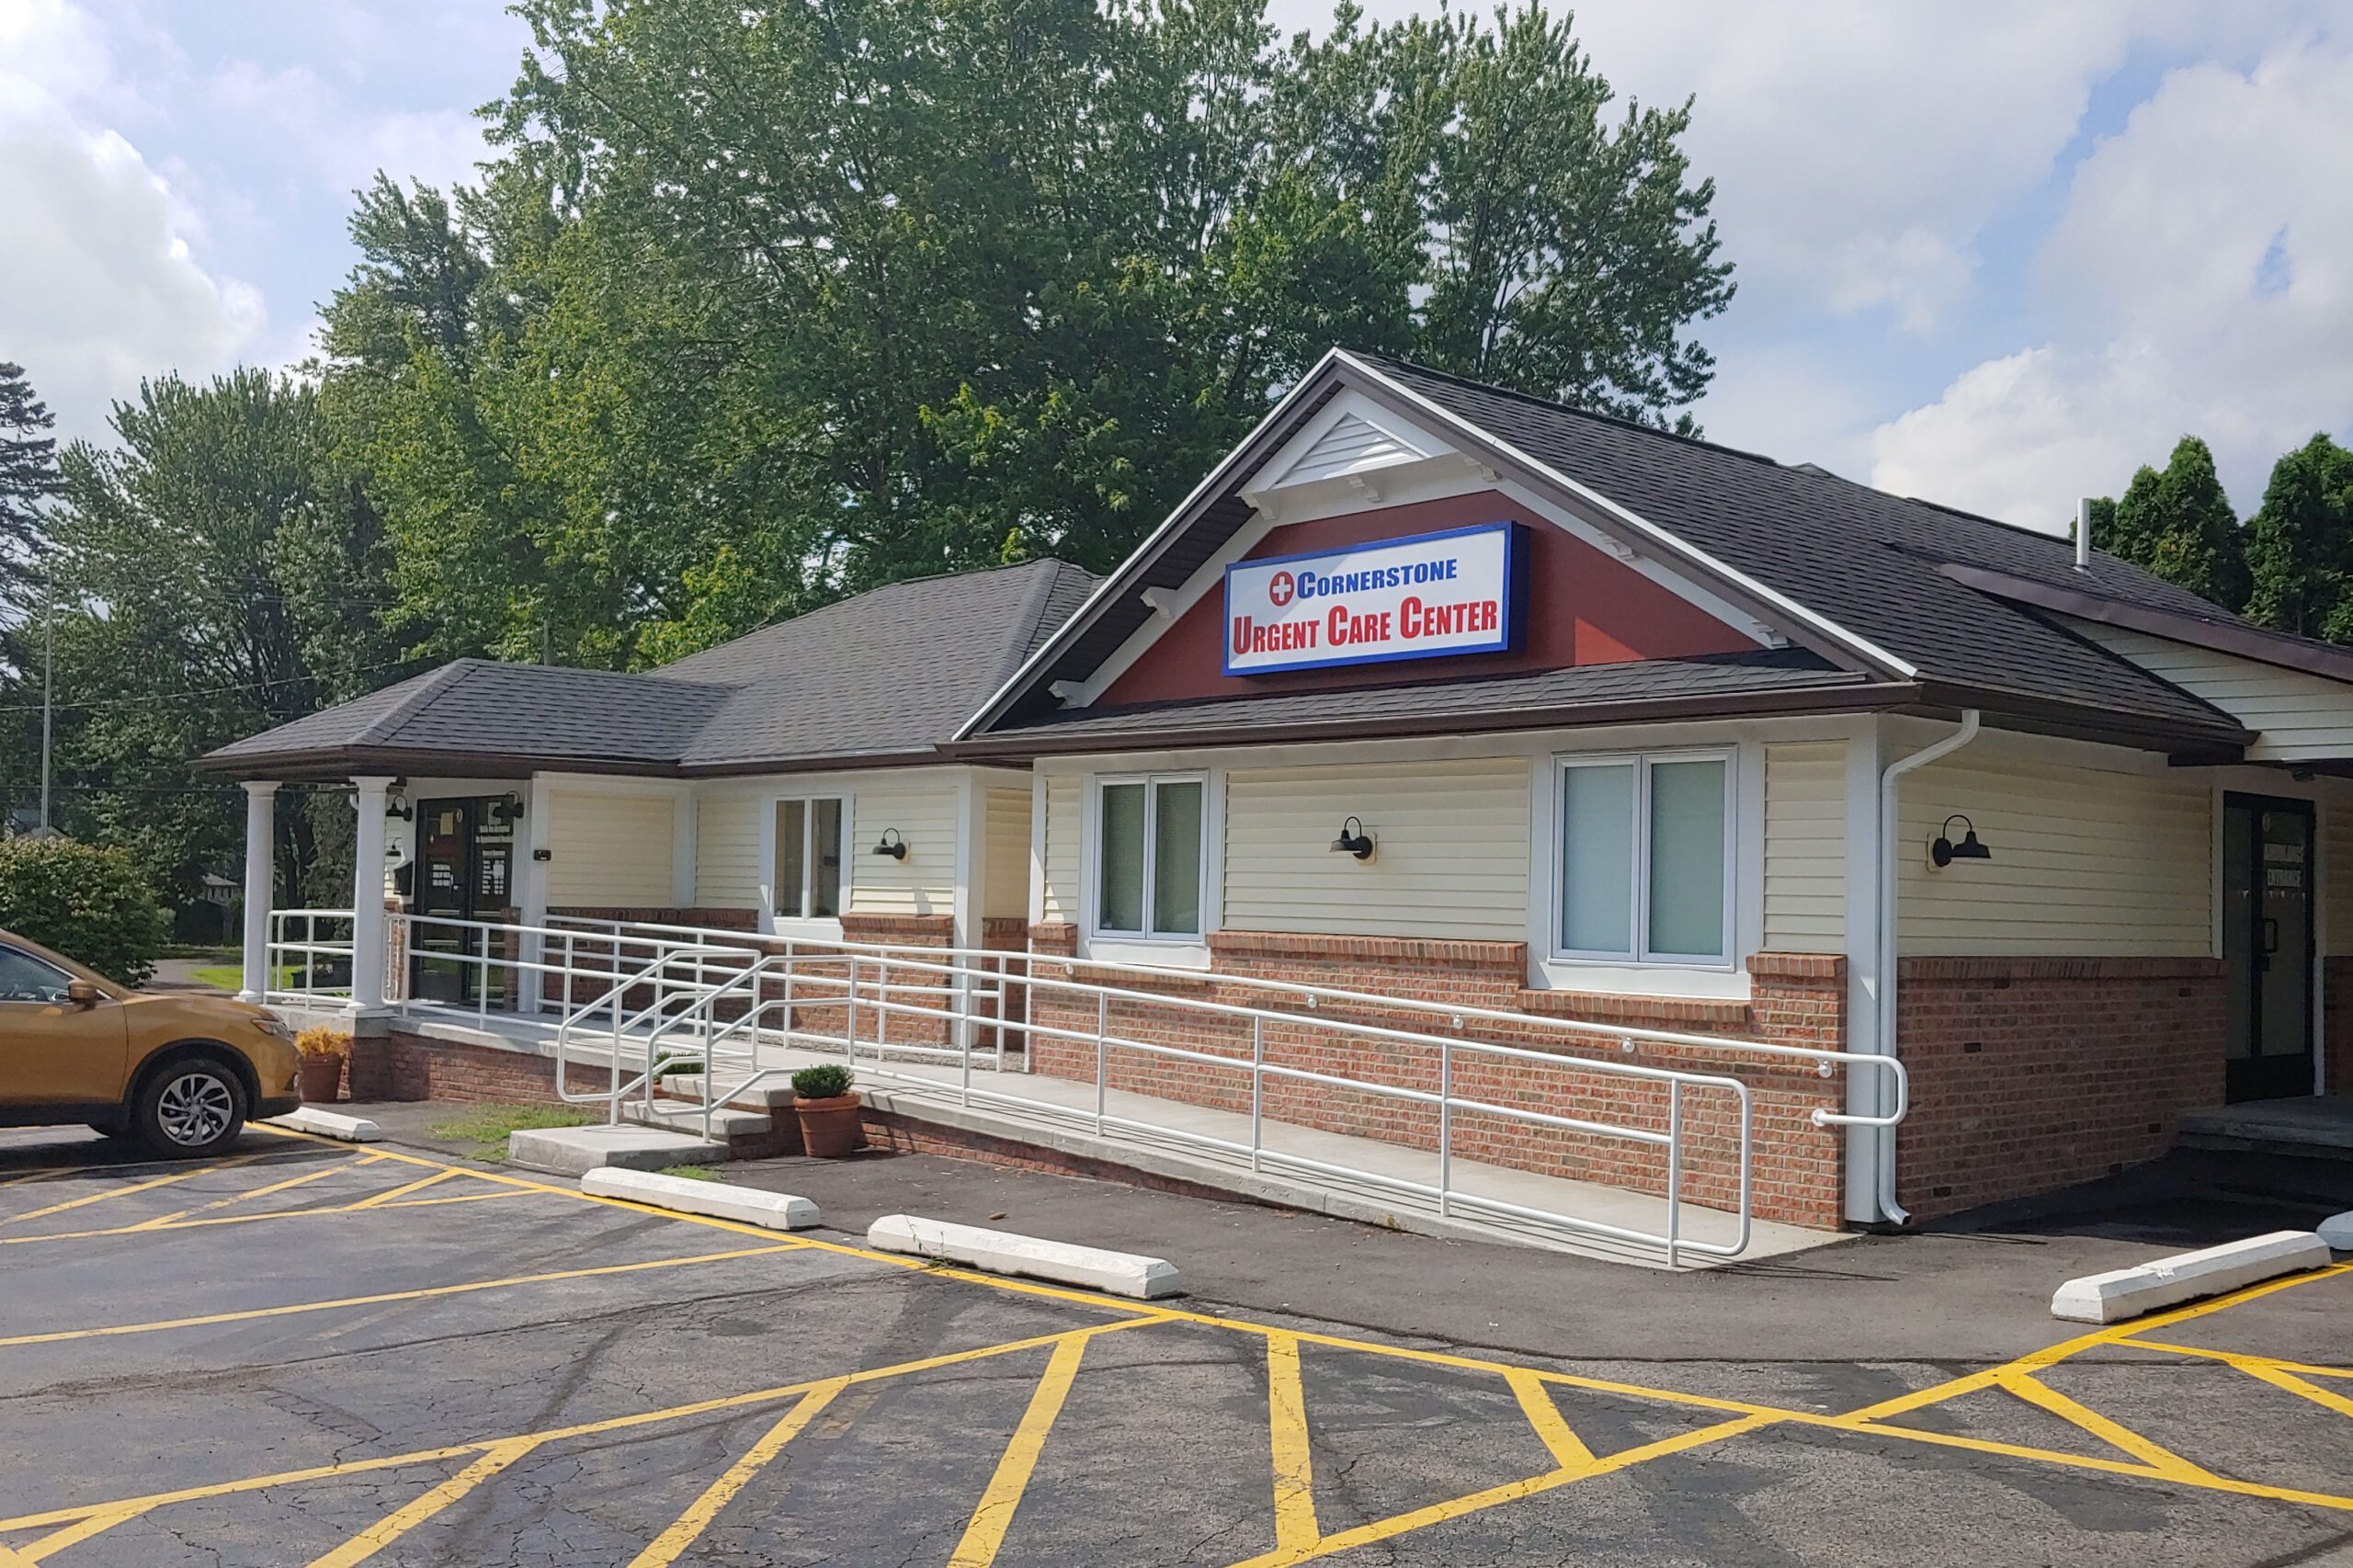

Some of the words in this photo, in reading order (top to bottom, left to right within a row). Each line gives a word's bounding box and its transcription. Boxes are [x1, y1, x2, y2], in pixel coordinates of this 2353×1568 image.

[1297, 558, 1457, 599] CORNERSTONE
[1233, 615, 1320, 654] URGENT
[1327, 606, 1391, 646] CARE
[1400, 596, 1497, 639] CENTER
